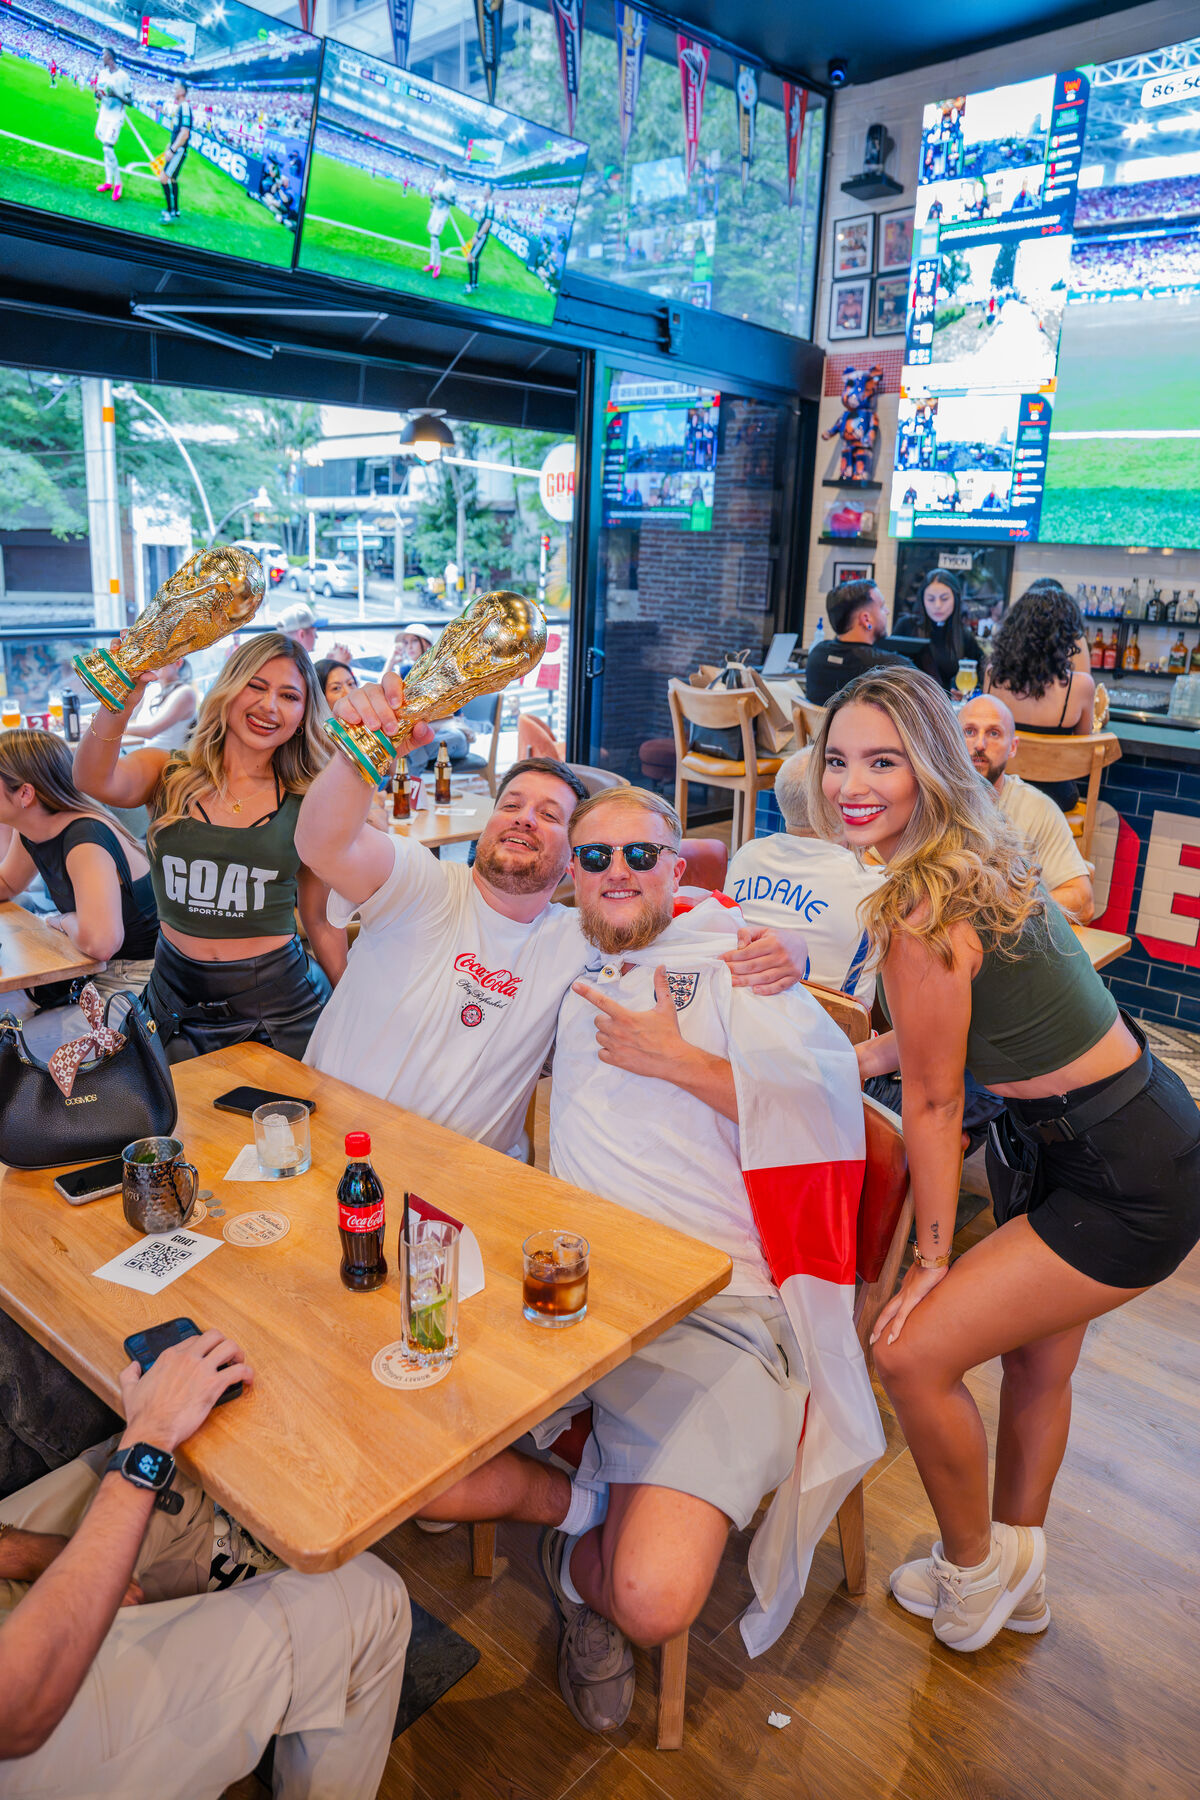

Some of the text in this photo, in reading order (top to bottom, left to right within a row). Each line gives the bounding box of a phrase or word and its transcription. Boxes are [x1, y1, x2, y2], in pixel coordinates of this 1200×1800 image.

[162, 855, 279, 911] GOAT
[733, 875, 829, 923] ZIDANE
[188, 906, 224, 917] SPORTS
[454, 952, 523, 998] Coca-Cola
[170, 1234, 198, 1247] GOAT
